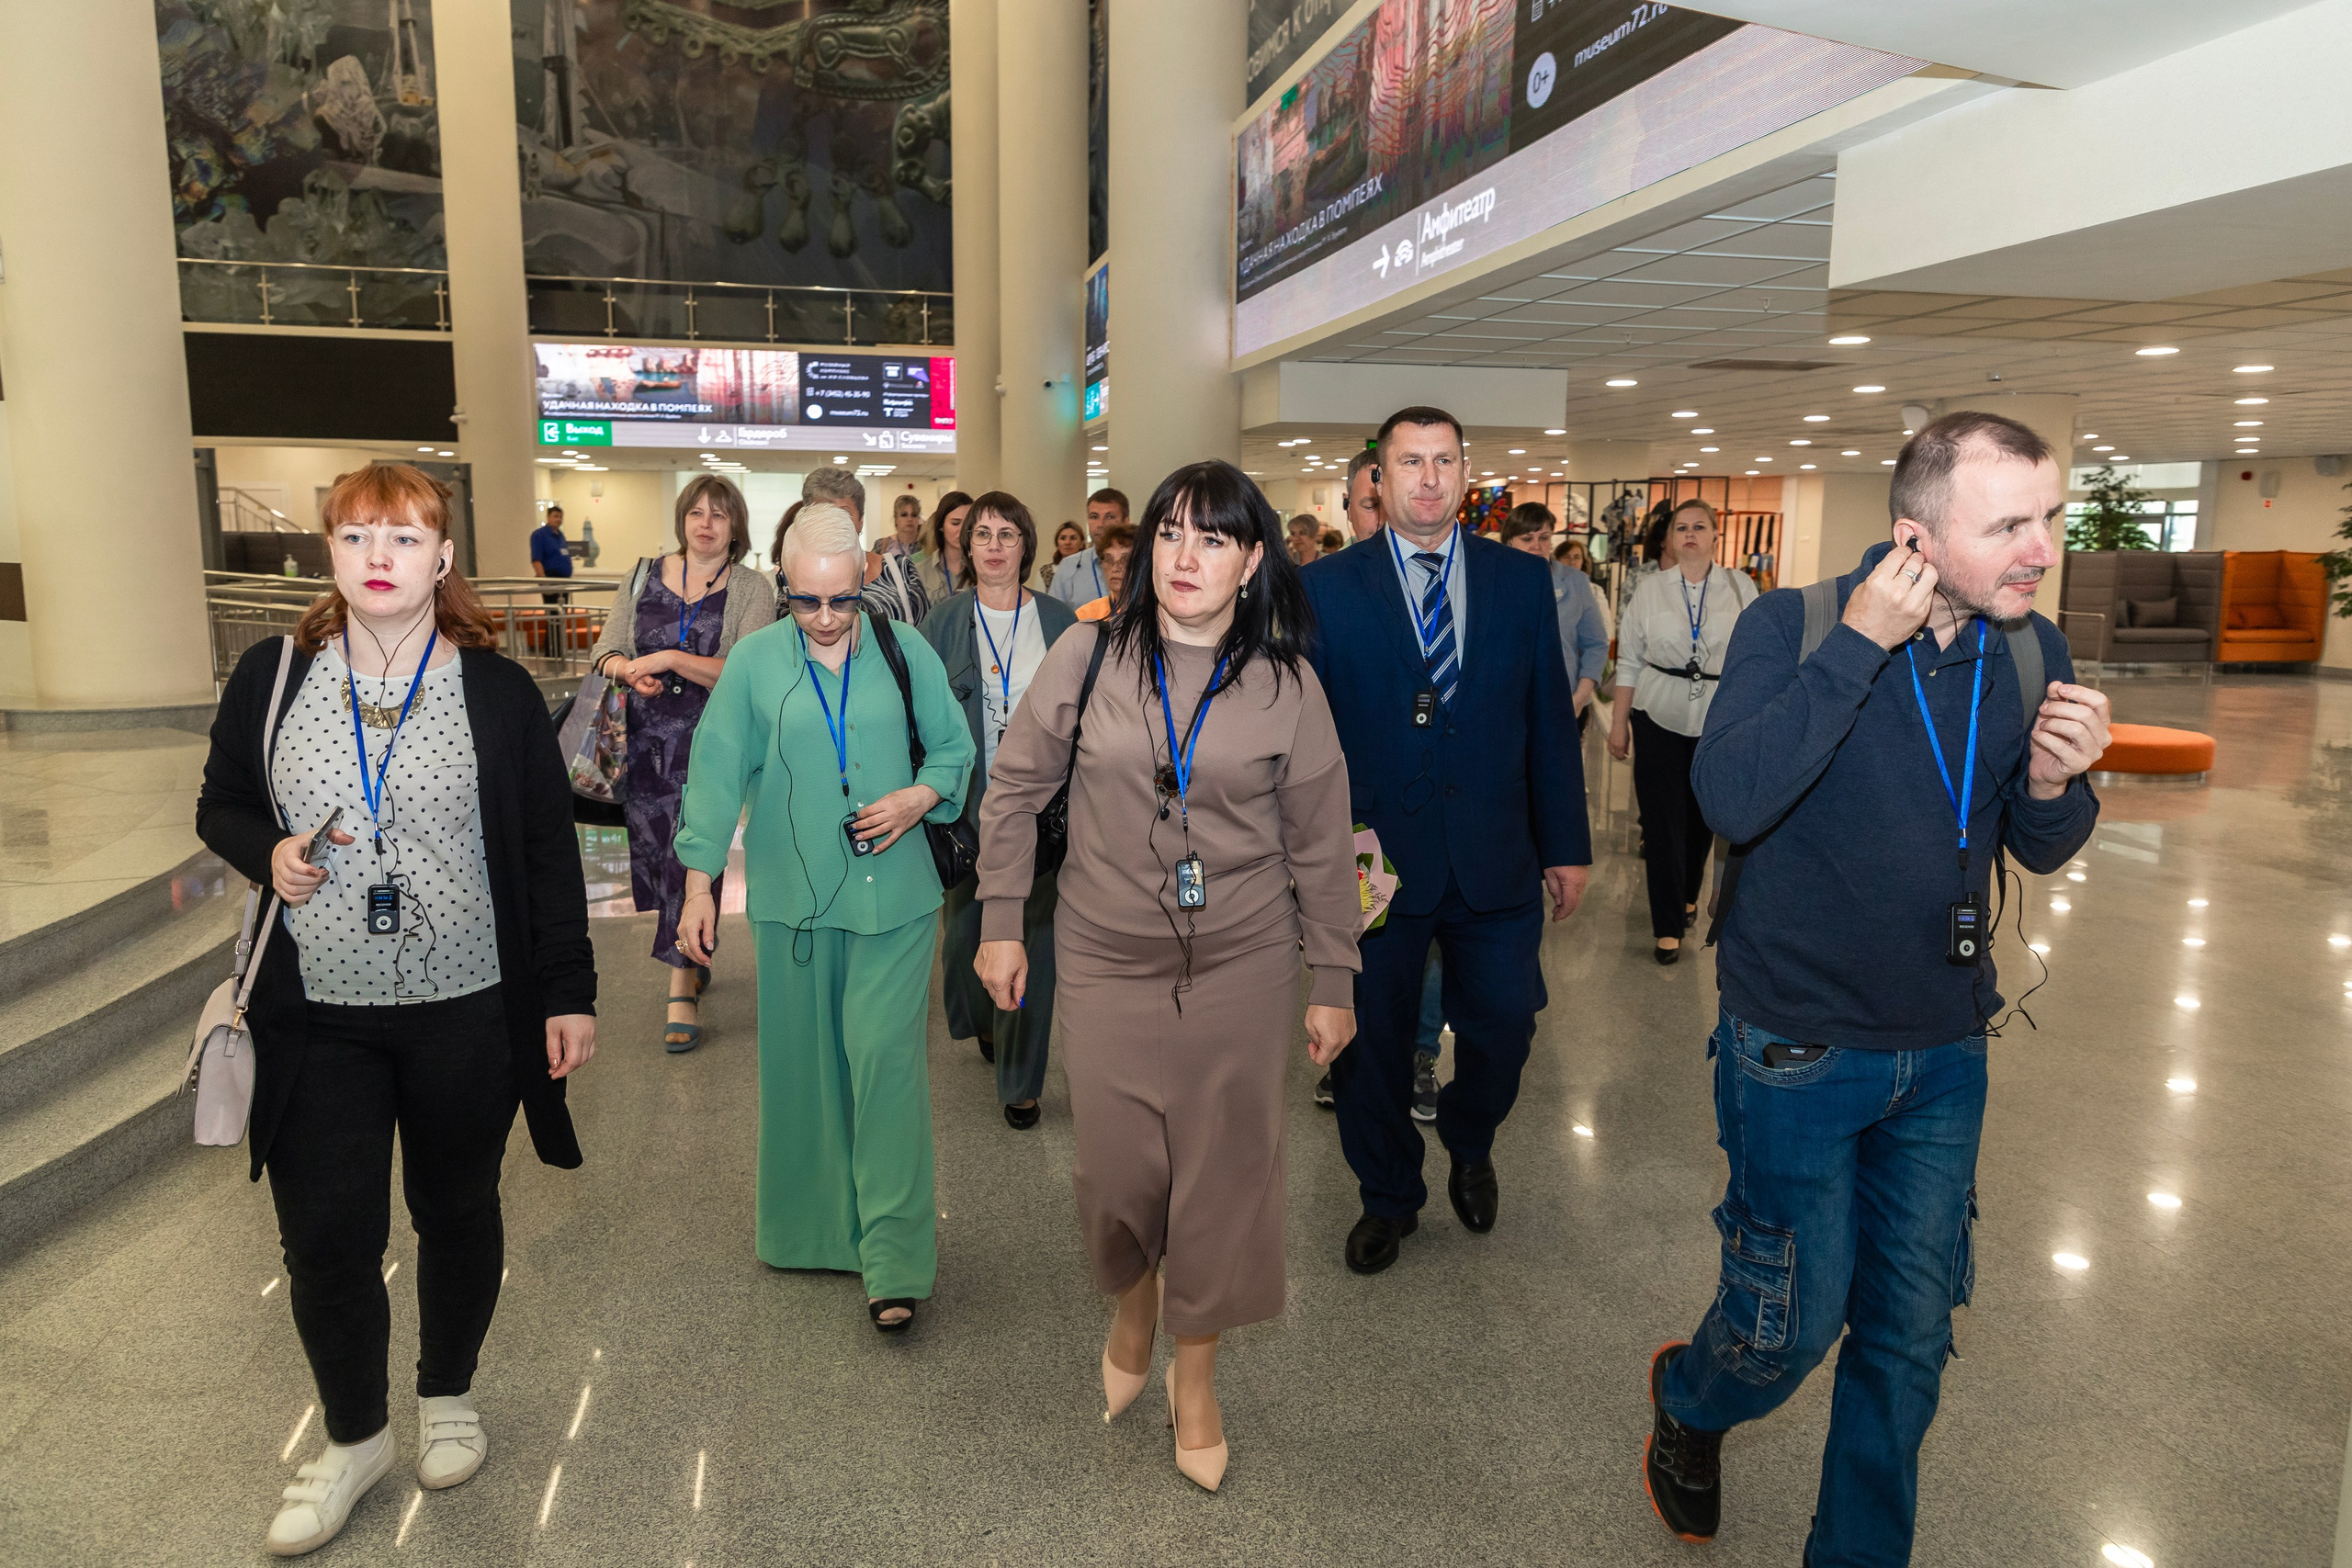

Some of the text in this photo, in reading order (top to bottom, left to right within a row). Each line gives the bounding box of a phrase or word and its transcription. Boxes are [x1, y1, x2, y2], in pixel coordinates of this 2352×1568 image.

[1574, 3, 1668, 69] museum72.ru
[1532, 66, 1550, 94] 0+
[1326, 173, 1383, 223] ПОМПЕЯХ
[1420, 186, 1496, 244] Амфитеатр
[542, 400, 713, 413] УДАЧНАЯ НАХОДКА В ПОМПЕЯХ
[565, 423, 605, 435] Выход
